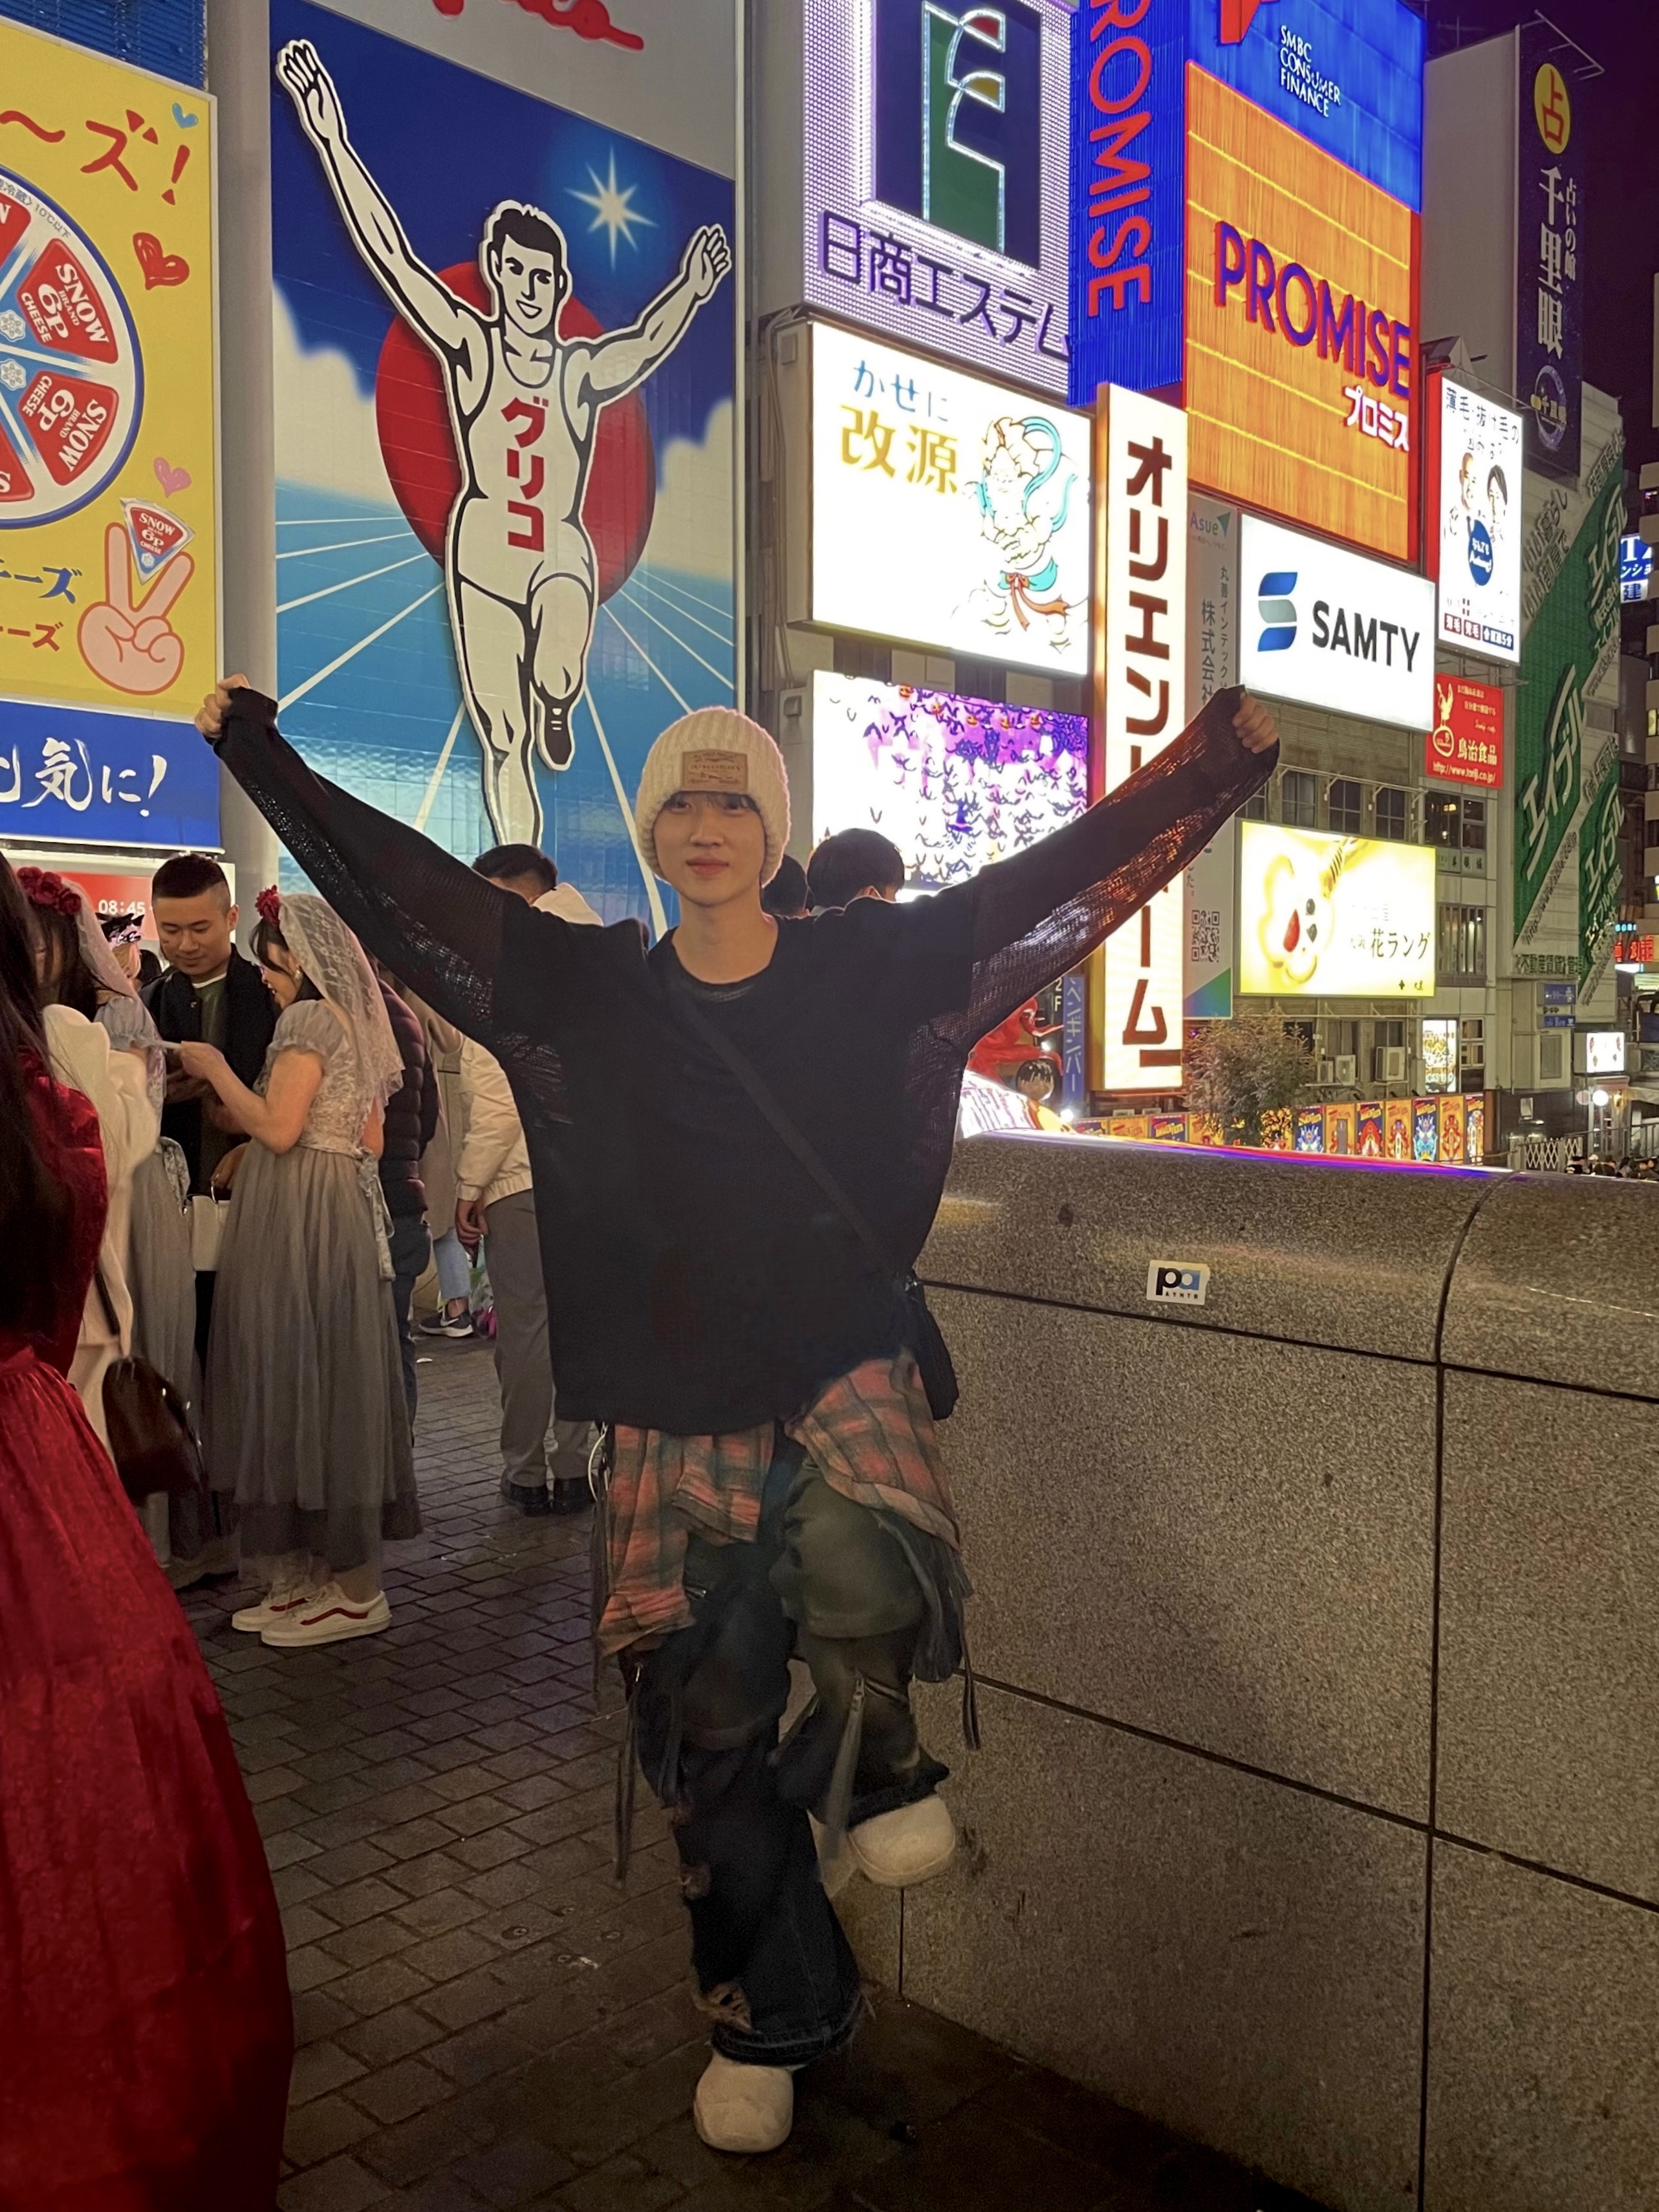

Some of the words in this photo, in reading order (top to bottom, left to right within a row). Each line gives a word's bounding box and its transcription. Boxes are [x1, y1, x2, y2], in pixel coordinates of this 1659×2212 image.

[1281, 25, 1312, 63] SMBC
[1280, 47, 1341, 105] CONSUMER
[1281, 68, 1329, 118] FINANCE
[1542, 69, 1565, 145] 占
[1537, 167, 1565, 360] 千里眼
[21, 292, 52, 343] CHEESE
[38, 283, 69, 339] 6P
[55, 263, 109, 343] SNOW
[59, 290, 80, 327] BRAND
[1215, 221, 1411, 400] PROMISE
[22, 375, 52, 417] CHEESE
[37, 389, 76, 431] 6P
[59, 408, 81, 438] BRAND
[1343, 385, 1410, 452] プロミス
[58, 398, 107, 473] SNOW
[840, 404, 959, 495] 改源
[500, 397, 549, 553] グリコ
[138, 512, 176, 536] SNOW
[141, 529, 165, 547] 6P
[1189, 511, 1219, 536] Asue
[1588, 484, 1628, 608] エイブル
[0, 557, 83, 604] ーズ
[0, 621, 63, 651] ーズ
[1312, 600, 1420, 673] SAMTY
[1122, 435, 1173, 1046] オリエンーム
[1523, 663, 1583, 881] エイブル
[1585, 783, 1625, 912] エイブル
[98, 899, 146, 916] 08:45
